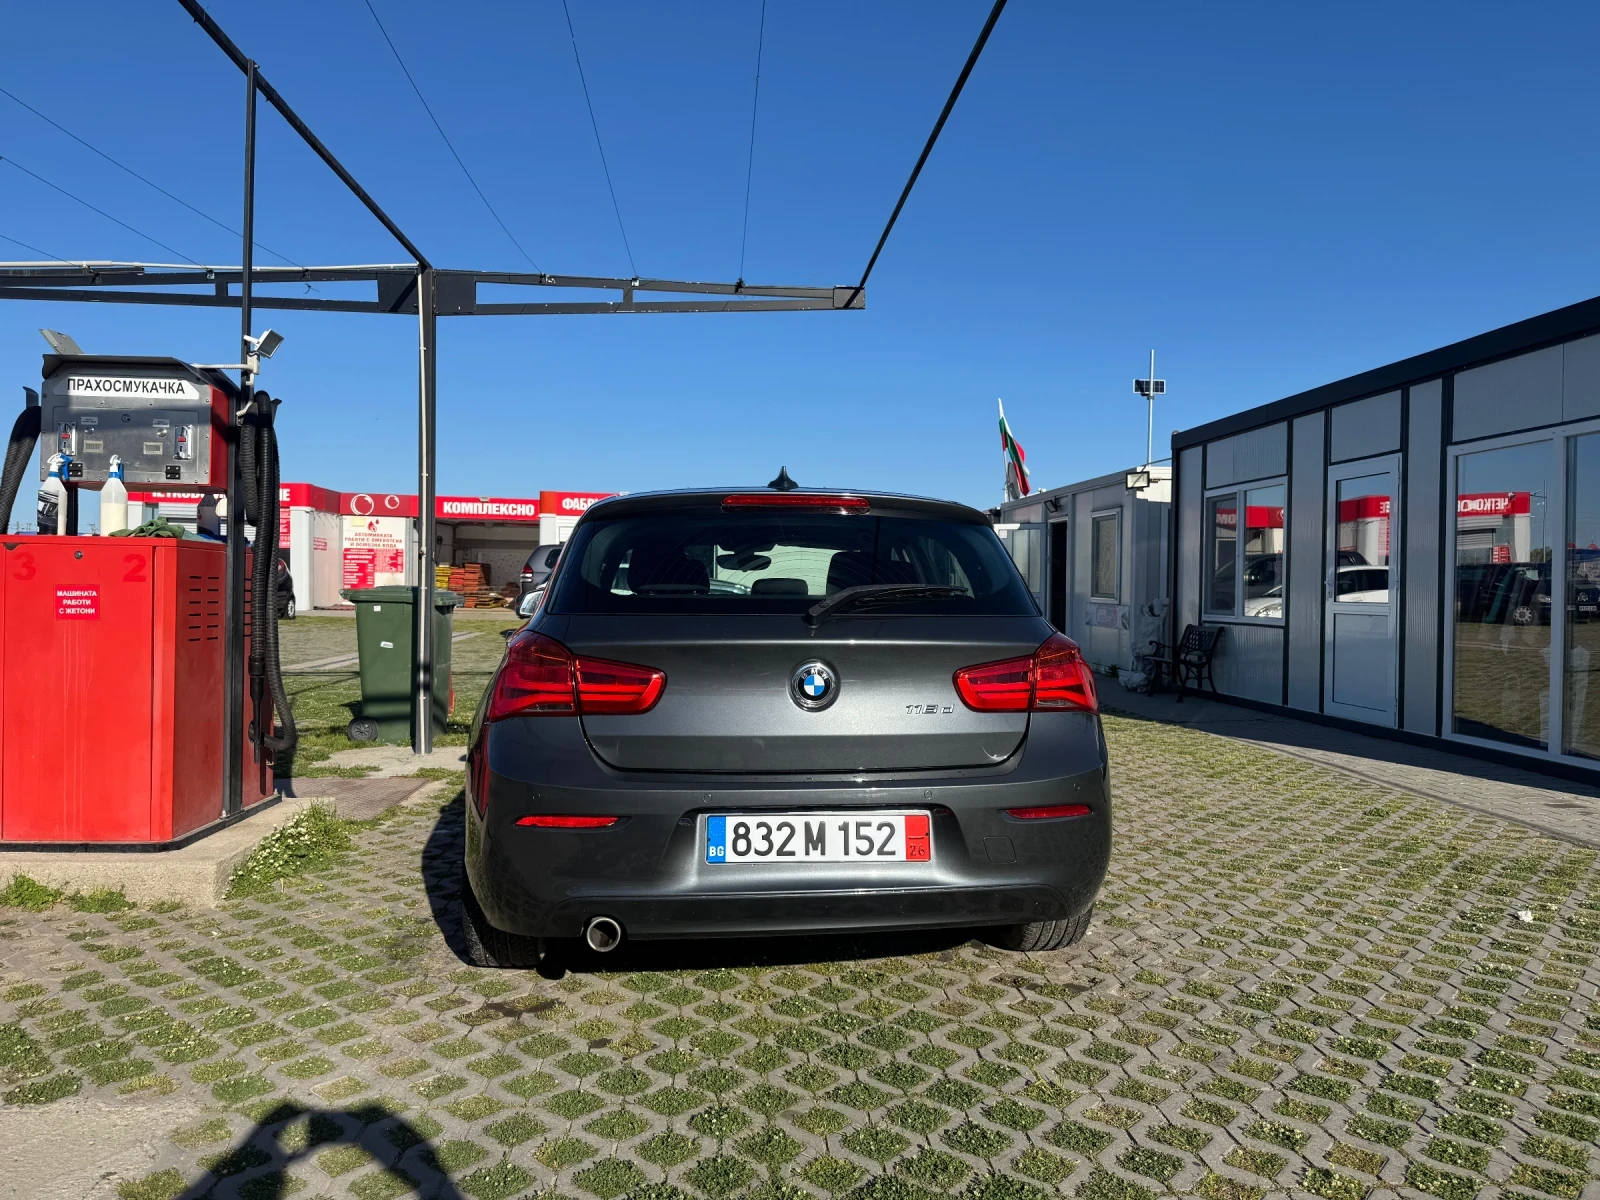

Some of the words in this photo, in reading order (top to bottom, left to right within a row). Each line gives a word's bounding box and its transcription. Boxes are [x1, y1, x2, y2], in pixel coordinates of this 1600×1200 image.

[67, 378, 186, 395] ПРАХОСМУКАЧКА
[443, 501, 535, 517] КОМПЛЕКСНО
[12, 551, 37, 581] 3
[122, 553, 147, 583] 2
[56, 590, 98, 598] МАШИНАТА
[800, 668, 829, 680] BMW
[731, 821, 797, 857] 832
[804, 820, 827, 856] M
[837, 820, 897, 856] 152
[709, 845, 725, 857] BG
[909, 843, 926, 857] 26
